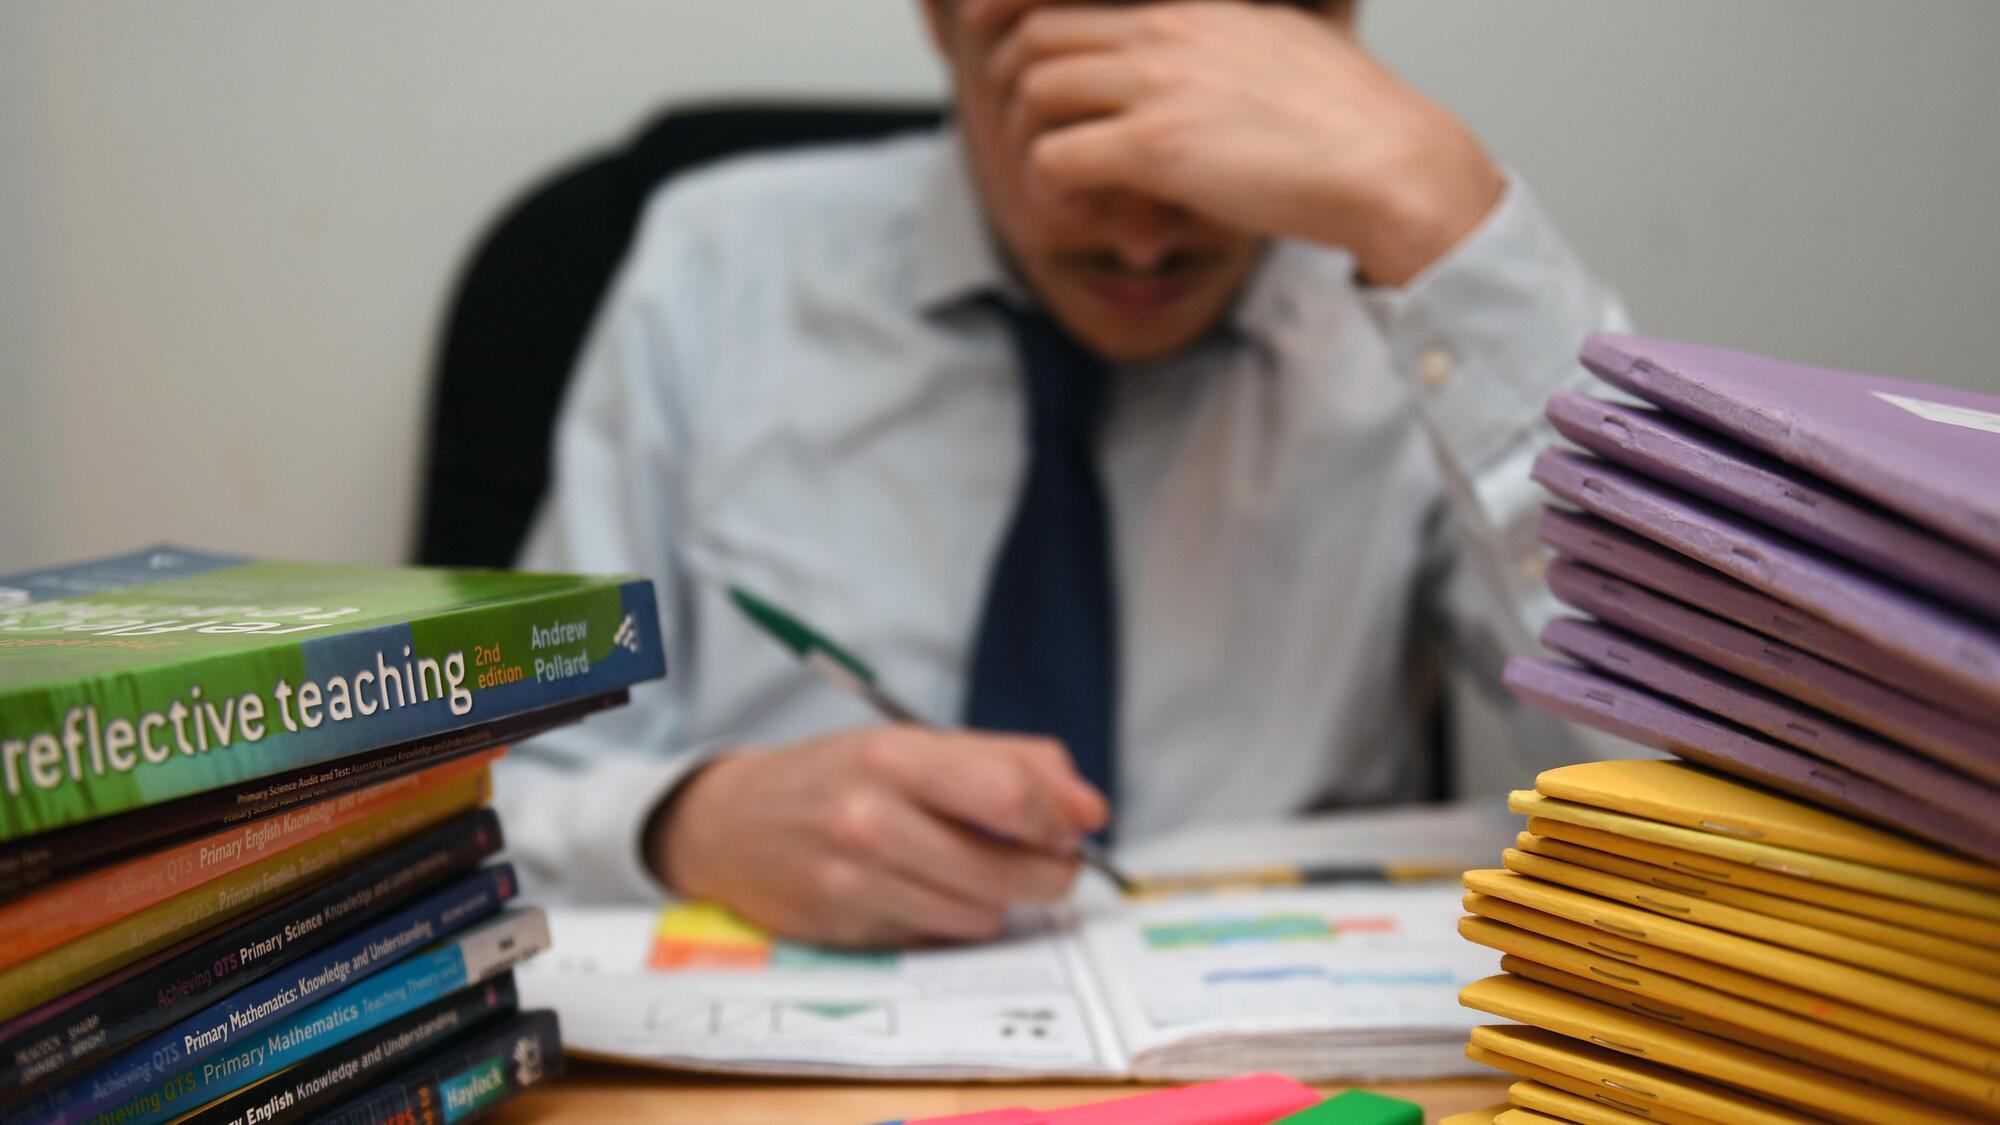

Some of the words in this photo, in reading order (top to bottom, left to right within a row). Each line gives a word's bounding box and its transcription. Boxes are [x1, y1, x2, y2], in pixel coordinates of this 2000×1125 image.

[474, 643, 500, 667] 2nd
[531, 620, 588, 650] Andrew
[478, 664, 523, 689] edition
[534, 650, 590, 684] Pollard
[1, 685, 266, 796] reflective
[275, 644, 473, 732] teaching
[237, 786, 268, 804] Primary
[268, 781, 298, 796] Science
[298, 773, 319, 788] Audit
[319, 770, 334, 782] and
[334, 767, 351, 779] Test:
[352, 757, 383, 774] Assessing
[382, 753, 398, 769] your
[398, 743, 432, 762] Knowledge
[167, 853, 193, 883] QTS
[200, 838, 242, 868] Primary
[245, 822, 281, 850] English
[284, 800, 337, 834] Knowledge
[338, 793, 355, 811] and
[219, 880, 260, 911] Primary
[262, 864, 297, 892] English
[157, 968, 212, 1007] Achieving
[214, 952, 239, 978] QTS
[240, 931, 282, 965] Primary
[284, 913, 322, 942] Science
[323, 887, 371, 922] Knowledge
[93, 1059, 151, 1100] Achieving
[153, 1043, 180, 1072] QTS
[184, 1021, 228, 1055] Primary
[229, 988, 298, 1032] Mathematics:
[299, 953, 351, 997] Knowledge
[352, 946, 369, 970] and
[371, 920, 434, 961] Understanding
[80, 1092, 161, 1125] chieving
[164, 1072, 196, 1102] QTS
[203, 1045, 265, 1084] Primary
[268, 1005, 359, 1056] Mathematics
[361, 985, 406, 1014] Teaching
[246, 1090, 294, 1125] English
[296, 1058, 359, 1101] Knowledge
[361, 1044, 381, 1067] and
[382, 1011, 459, 1058] Understanding
[446, 1064, 502, 1110] Haylock
